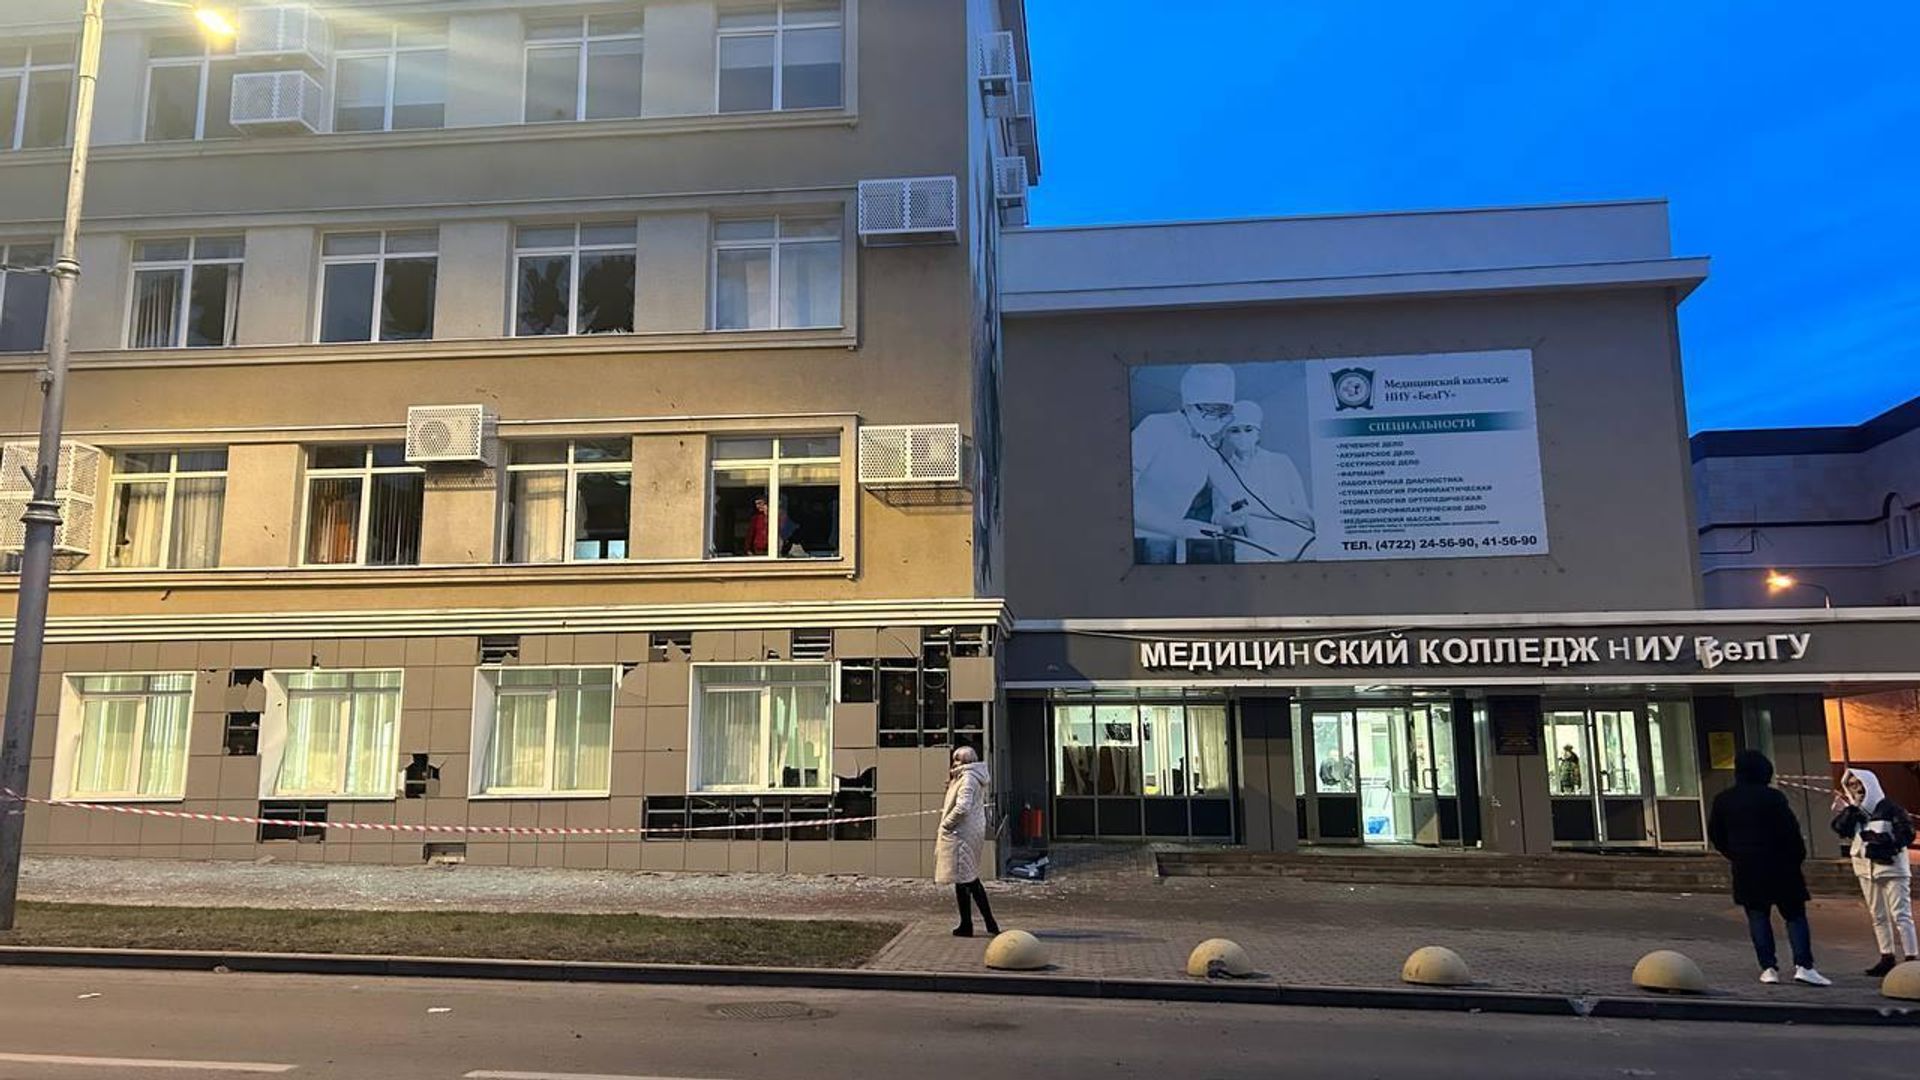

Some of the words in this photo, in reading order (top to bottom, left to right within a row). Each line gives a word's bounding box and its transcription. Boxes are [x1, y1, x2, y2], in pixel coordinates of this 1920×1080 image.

[1384, 376, 1460, 389] Медицинский
[1462, 374, 1510, 386] колледж
[1385, 390, 1410, 402] НИУ
[1368, 418, 1476, 432] СПЕЦИАЛЬНОСТИ
[1342, 541, 1372, 550] ТЕЛ.
[1376, 540, 1415, 551] (4722)
[1419, 537, 1478, 549] 24-56-90,
[1482, 535, 1537, 546] 41-56-90
[1140, 632, 1409, 671] МЕДИЦИНСКИЙ
[1420, 636, 1600, 668] КОЛЛЕДЖ
[1608, 635, 1684, 662] НИУ
[1694, 633, 1812, 669] БелГУ
